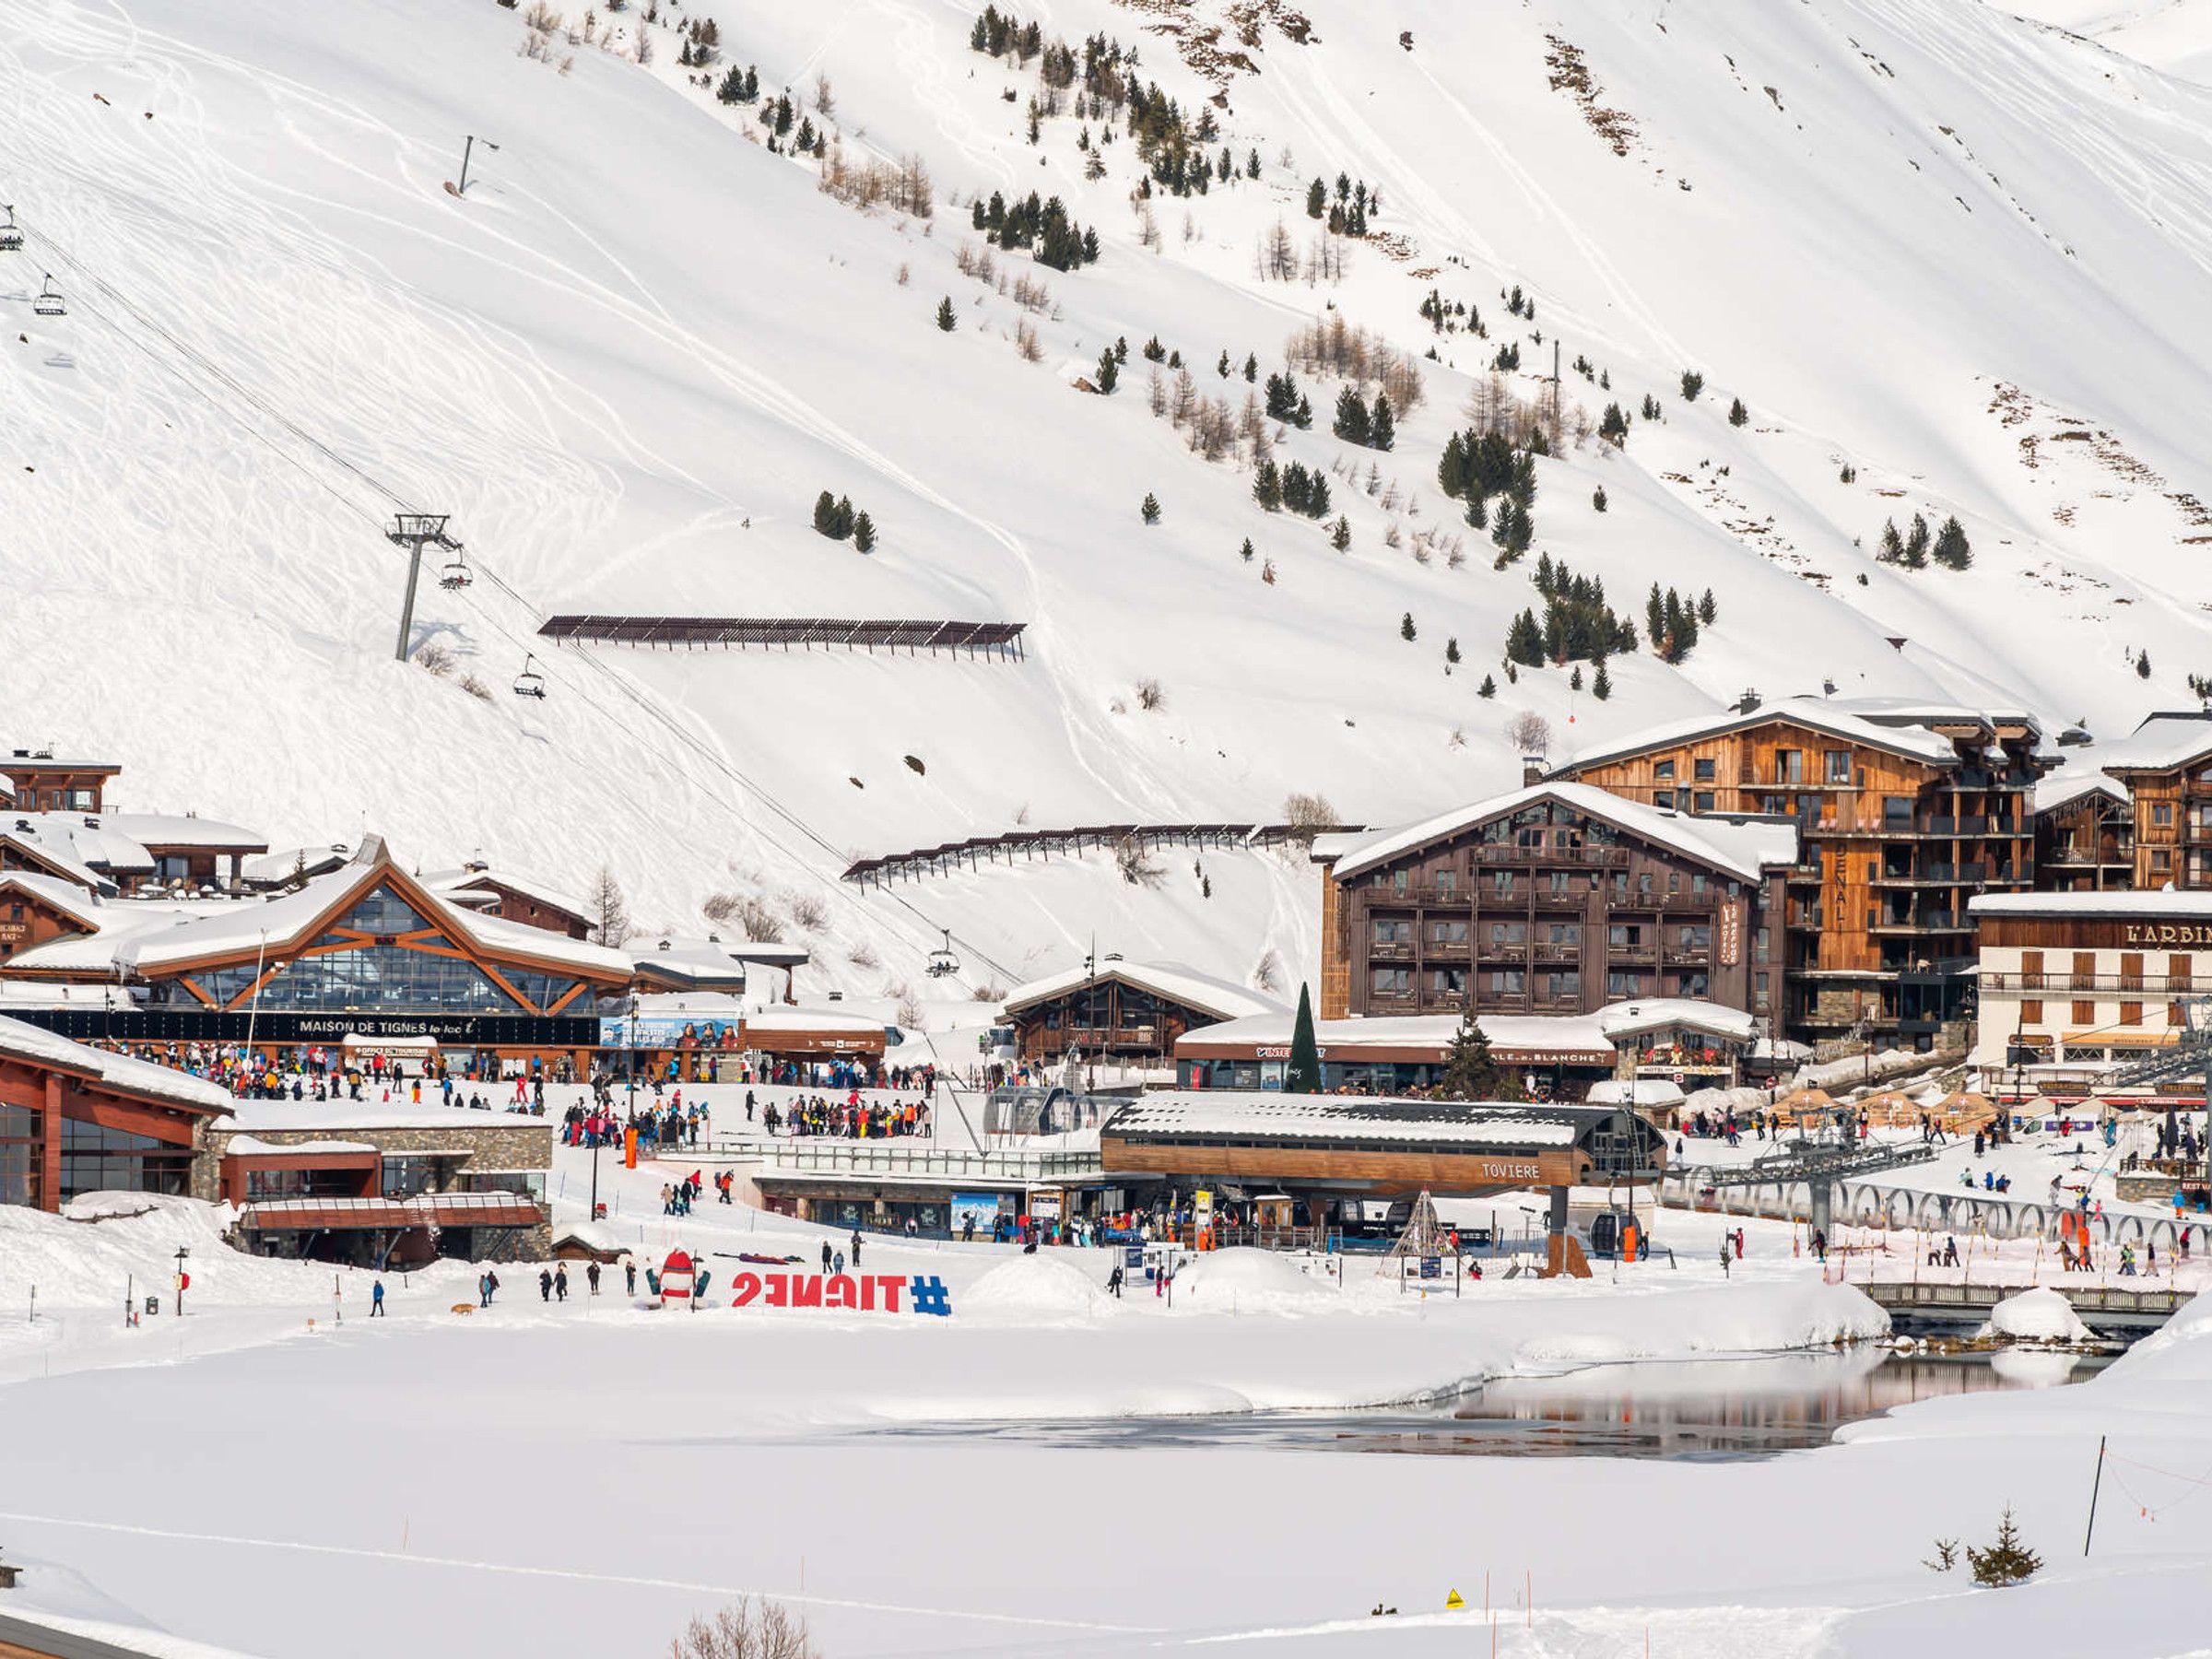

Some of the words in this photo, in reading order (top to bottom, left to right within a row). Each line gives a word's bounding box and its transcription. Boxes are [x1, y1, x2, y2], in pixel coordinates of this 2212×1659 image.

[300, 1020, 355, 1032] MAISON
[358, 1021, 376, 1033] DE
[379, 1021, 427, 1033] TIGNES
[1535, 1053, 1595, 1062] BLANCHE
[1482, 1163, 1540, 1179] TOVIERE
